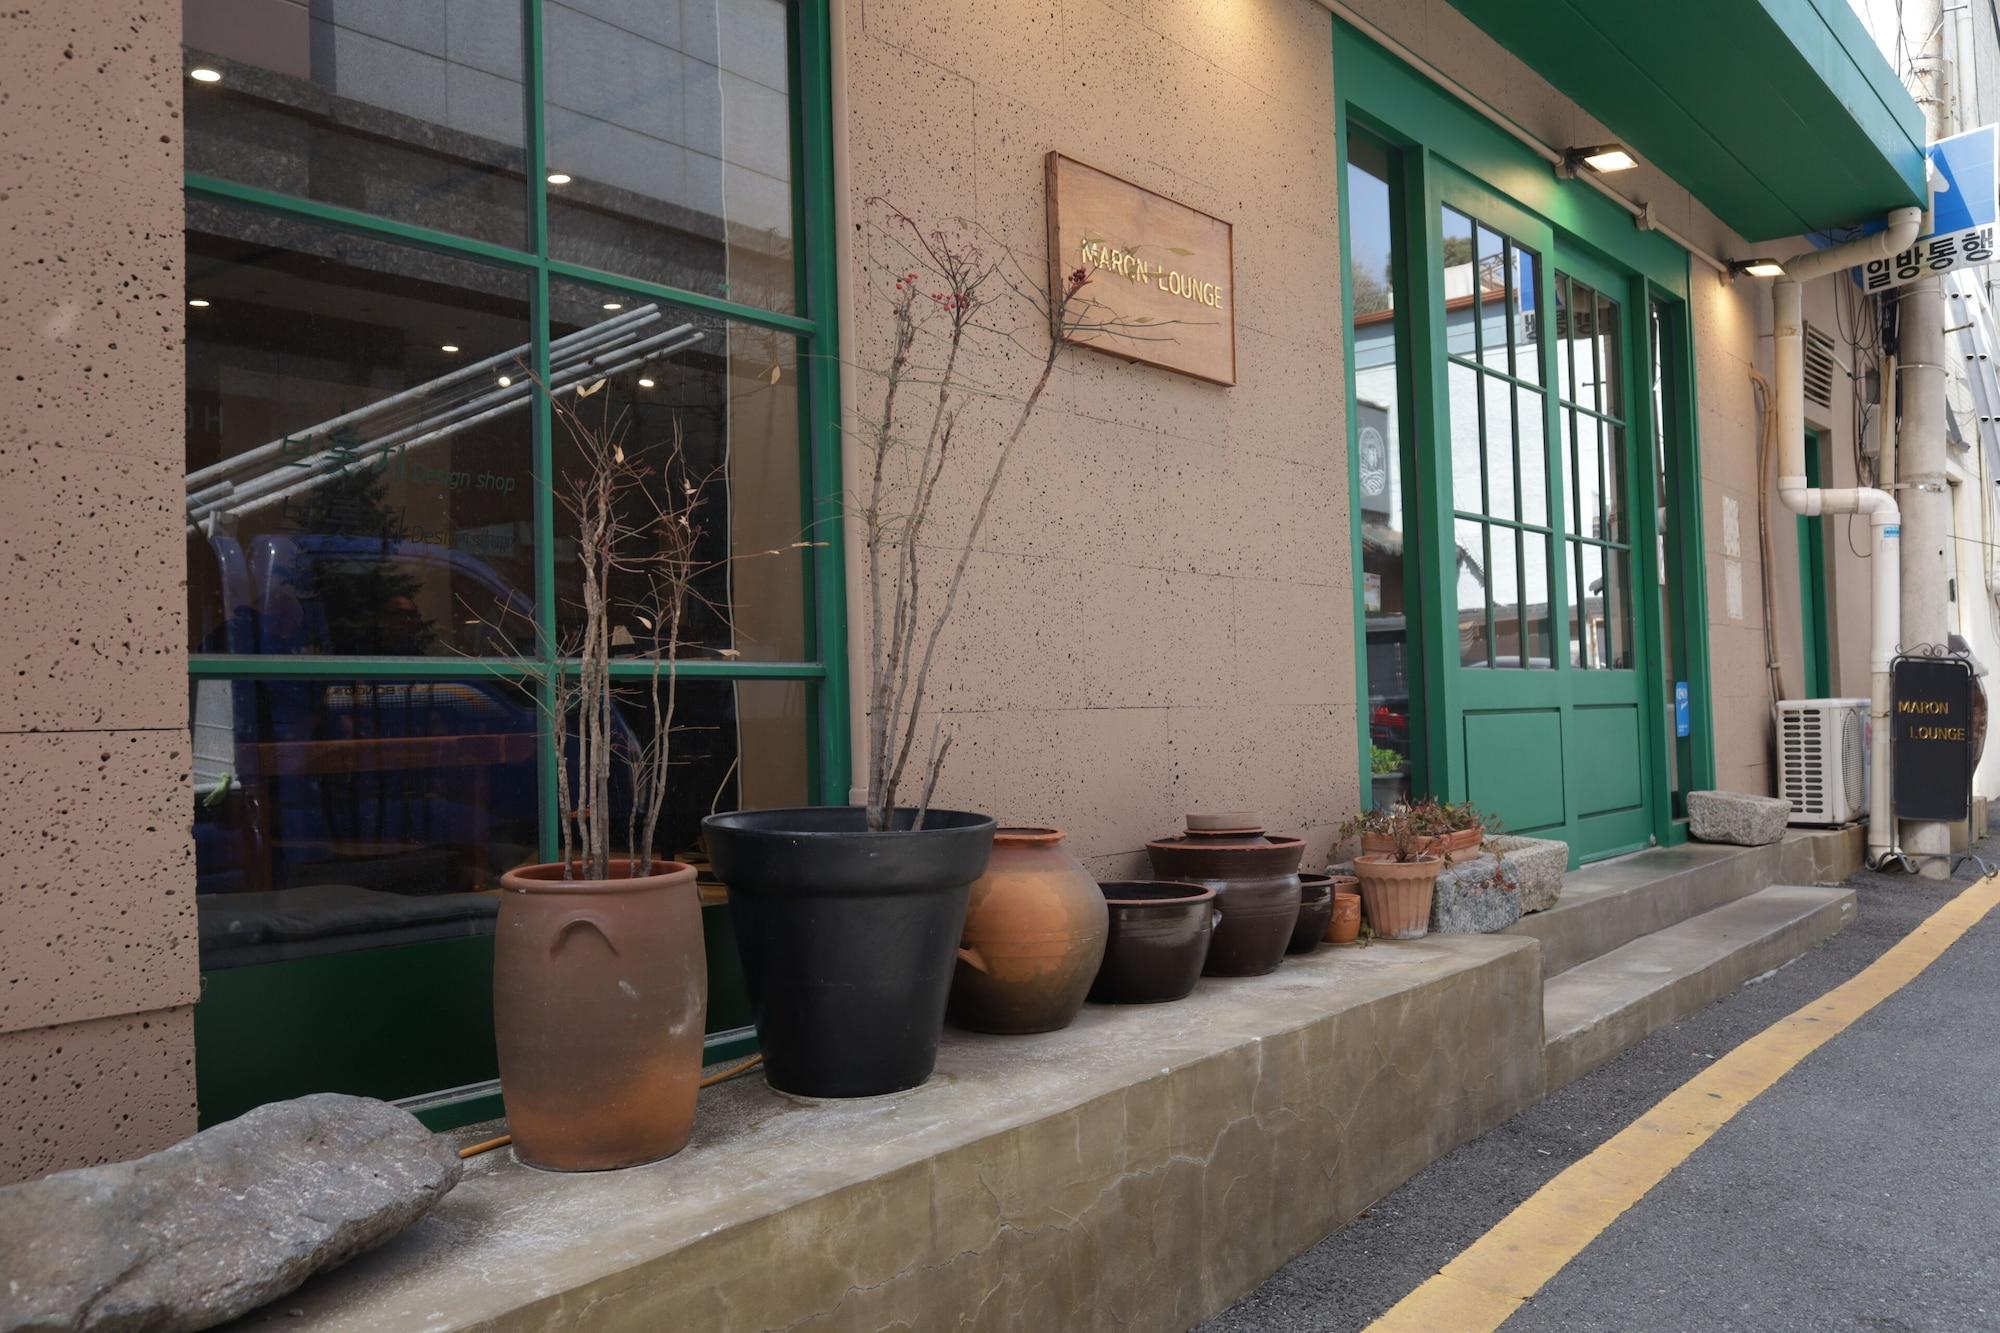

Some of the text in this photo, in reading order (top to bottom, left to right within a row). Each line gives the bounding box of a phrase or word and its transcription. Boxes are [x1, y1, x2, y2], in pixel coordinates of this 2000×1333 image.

[1866, 227, 1993, 289] 일방통행
[1158, 265, 1224, 309] LOUNGE
[476, 469, 516, 497] shop
[1898, 701, 1949, 715] MARON
[1909, 726, 1966, 741] LOUNGE
